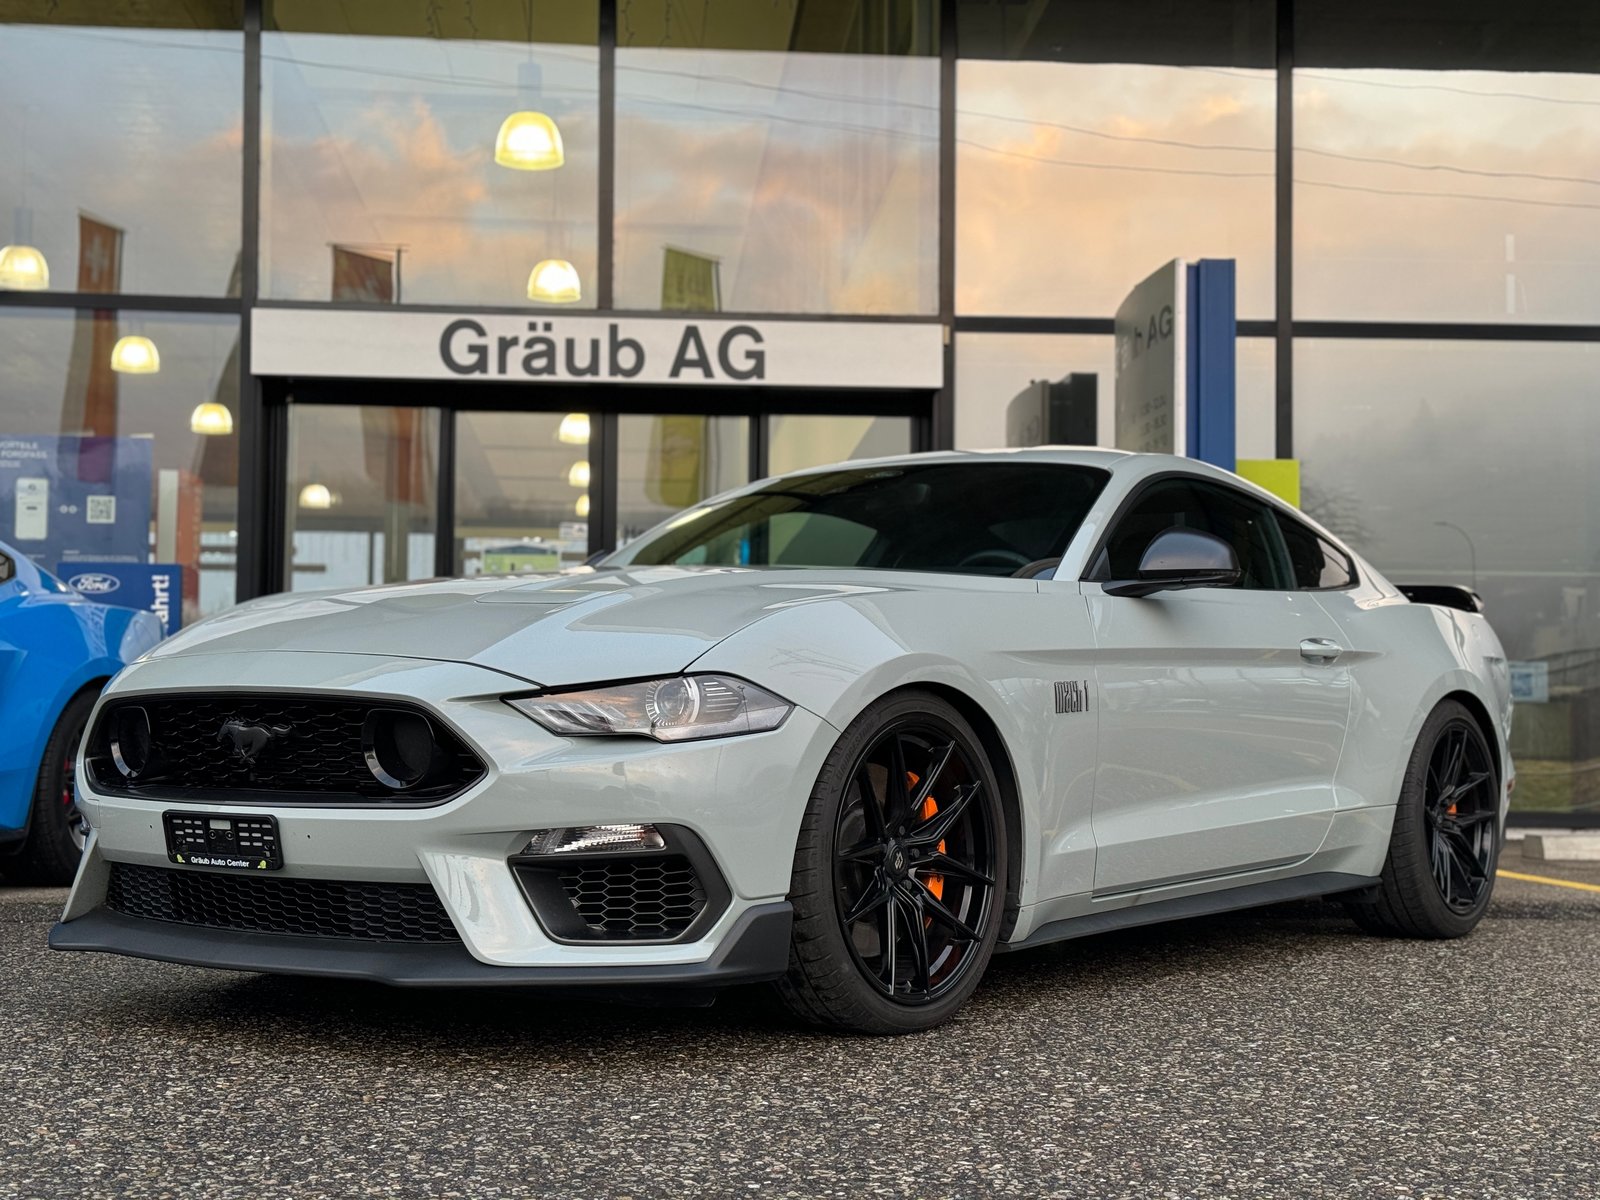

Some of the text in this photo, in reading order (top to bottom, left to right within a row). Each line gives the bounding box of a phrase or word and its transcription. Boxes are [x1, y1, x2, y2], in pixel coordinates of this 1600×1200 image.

[439, 318, 766, 380] Gräub AG
[1147, 304, 1173, 349] AG
[77, 575, 111, 590] Ford
[150, 574, 170, 624] ahrt!
[190, 856, 250, 867] Gräub Auto Center
